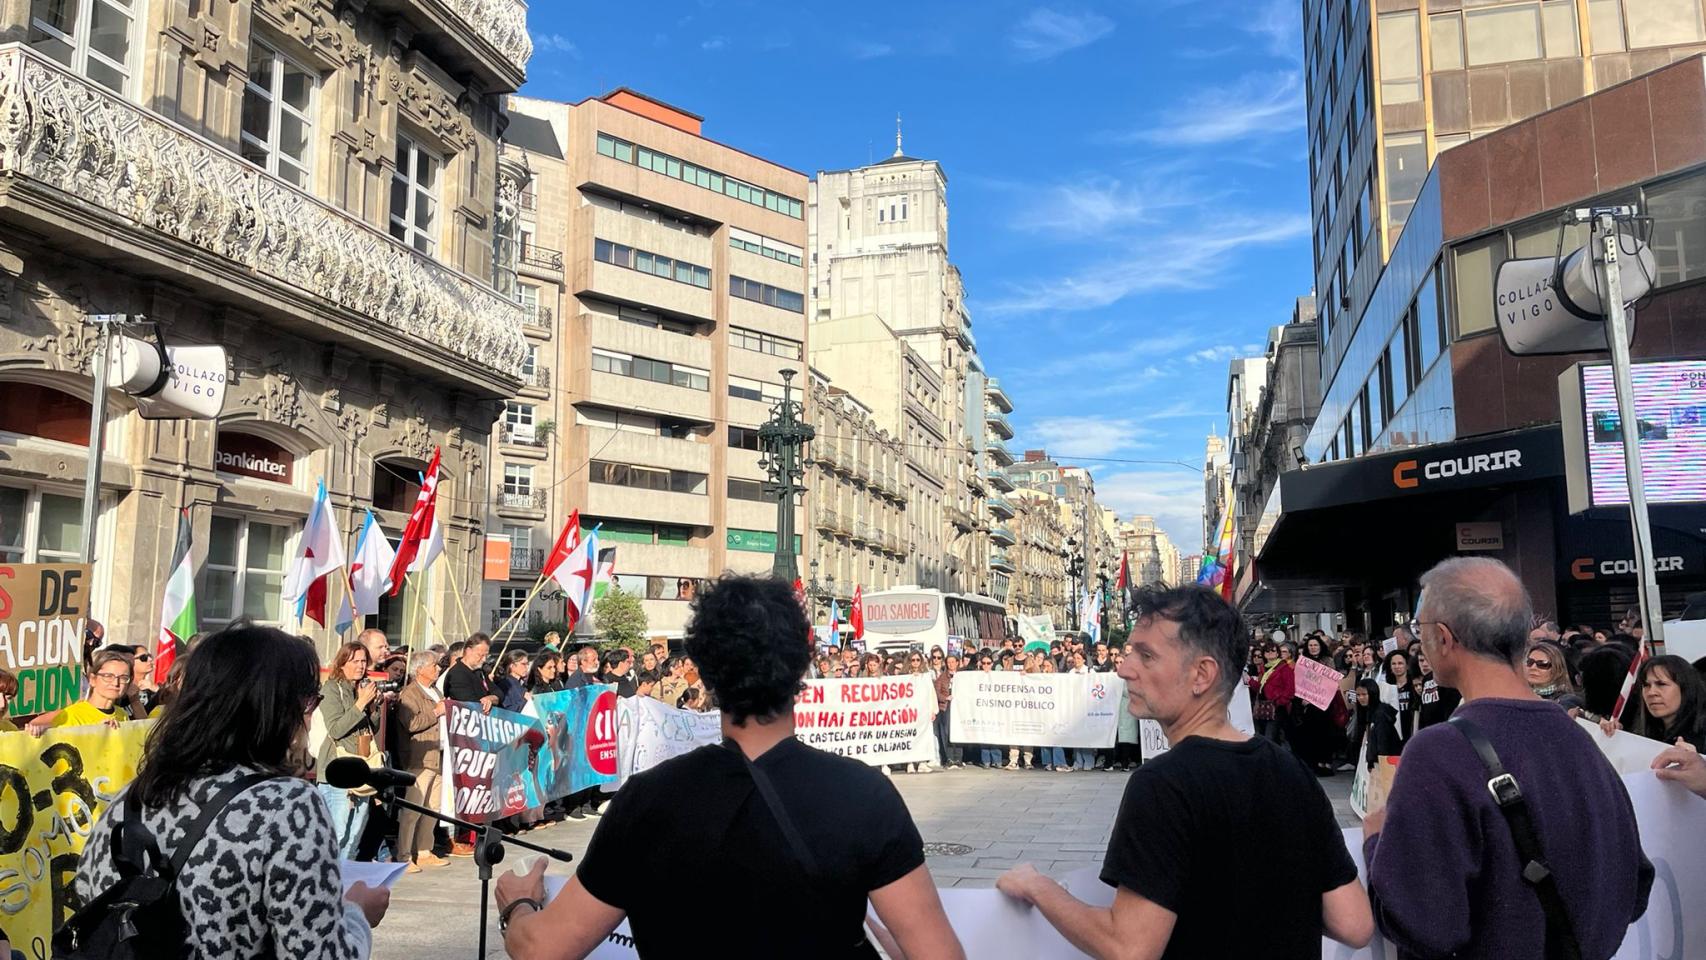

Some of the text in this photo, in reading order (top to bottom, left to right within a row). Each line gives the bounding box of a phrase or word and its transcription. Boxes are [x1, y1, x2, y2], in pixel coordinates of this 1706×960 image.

[1508, 298, 1553, 325] VIGO
[174, 378, 215, 398] VIGO
[1424, 449, 1522, 480] COURIR
[1461, 537, 1500, 545] COURIR
[39, 569, 82, 617] DE
[867, 602, 930, 621] DOA SANGUE
[841, 682, 914, 703] RECURSOS
[978, 683, 1053, 695] EN DEFENSA DO
[976, 698, 1012, 709] ENSINO
[809, 731, 856, 743] CASTELAO
[860, 730, 873, 740] POR
[876, 730, 888, 739] UN
[847, 746, 853, 756] E
[856, 744, 868, 755] DE
